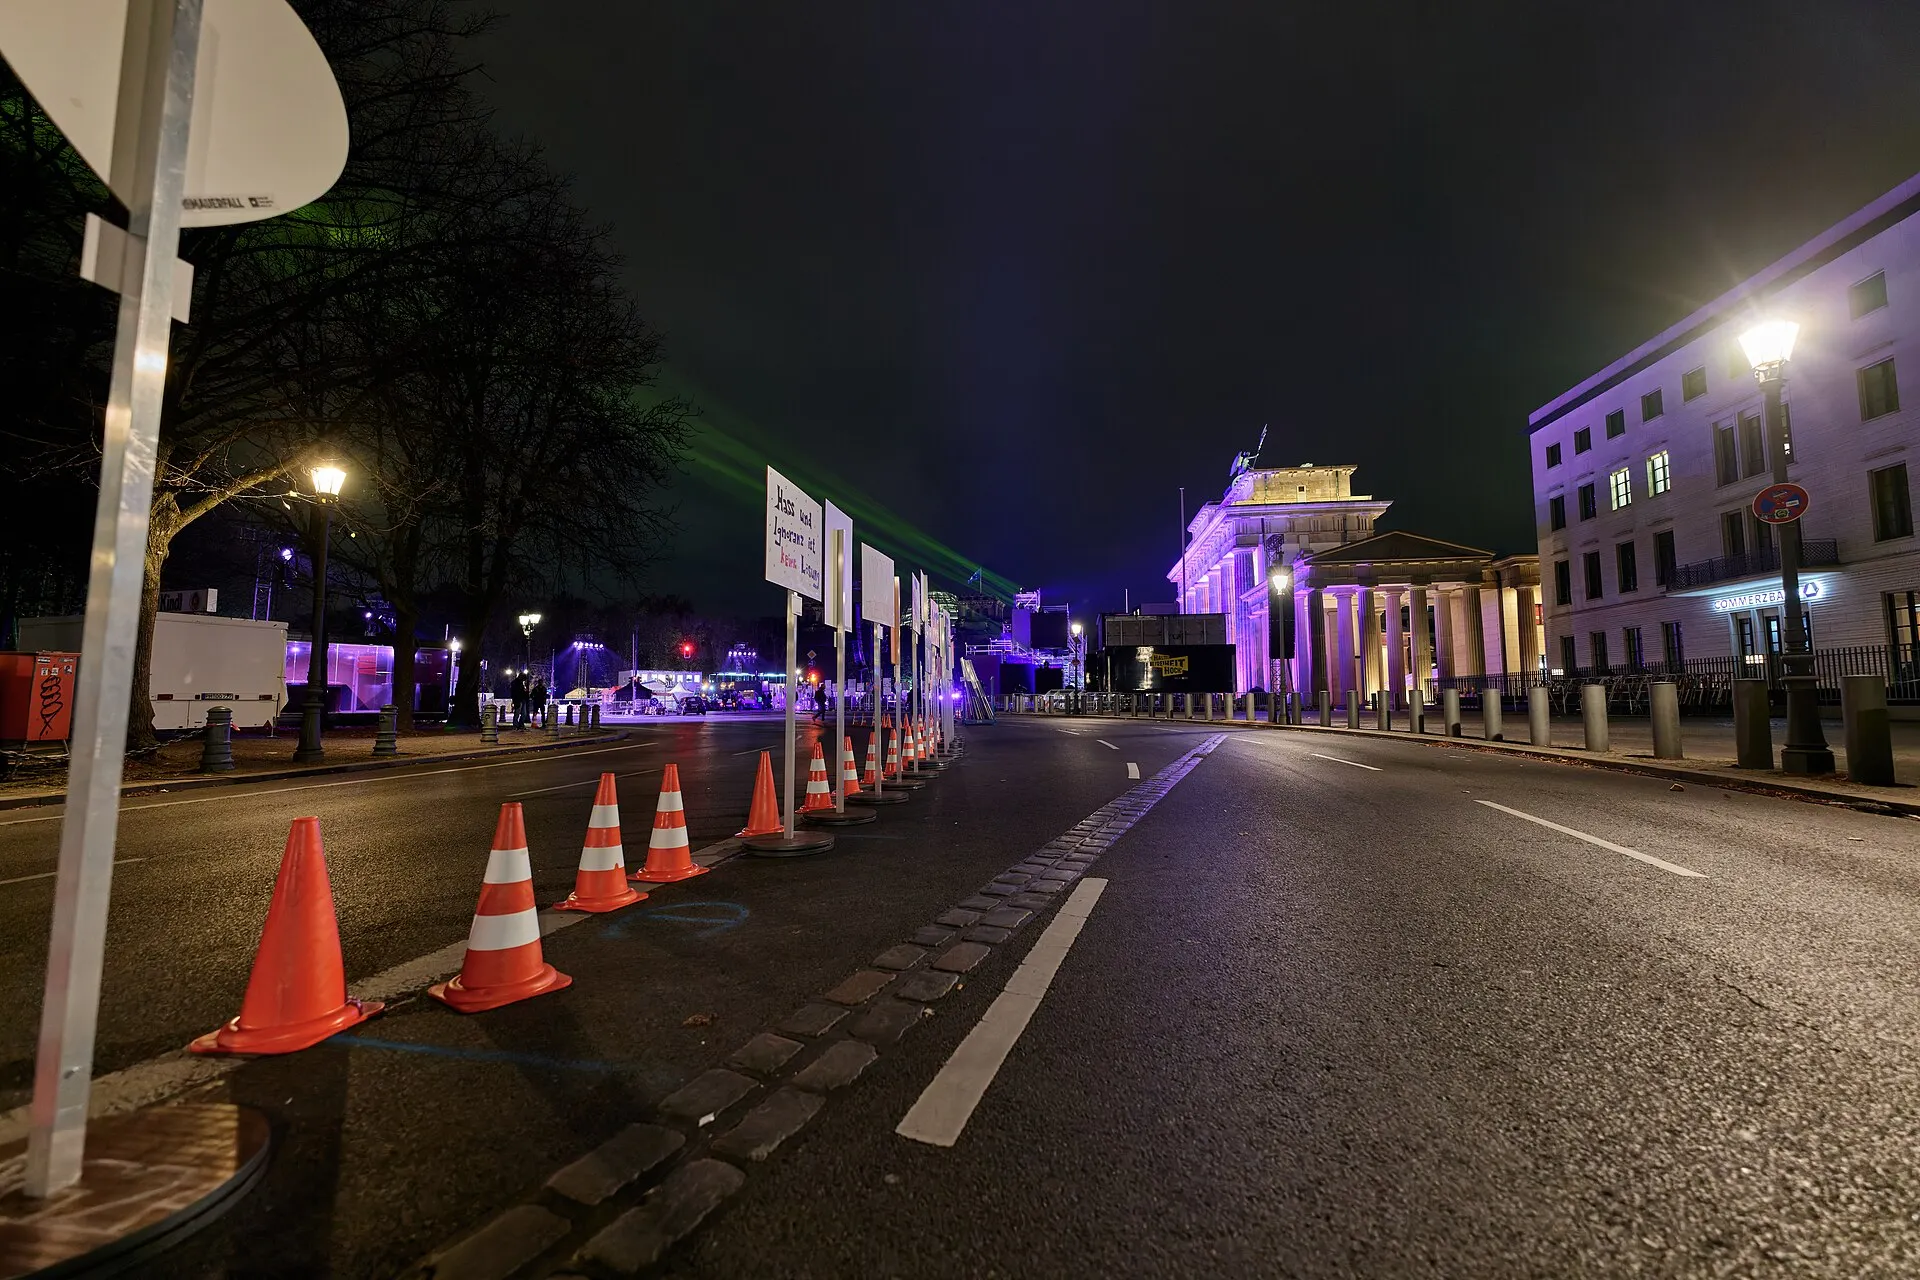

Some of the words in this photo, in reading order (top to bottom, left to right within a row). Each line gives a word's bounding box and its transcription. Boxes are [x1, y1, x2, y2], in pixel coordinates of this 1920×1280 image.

[775, 484, 795, 517] Hass
[799, 508, 813, 530] und
[773, 515, 804, 547] Ignoranz
[807, 537, 816, 555] ist
[1714, 591, 1785, 610] COMMERZBA
